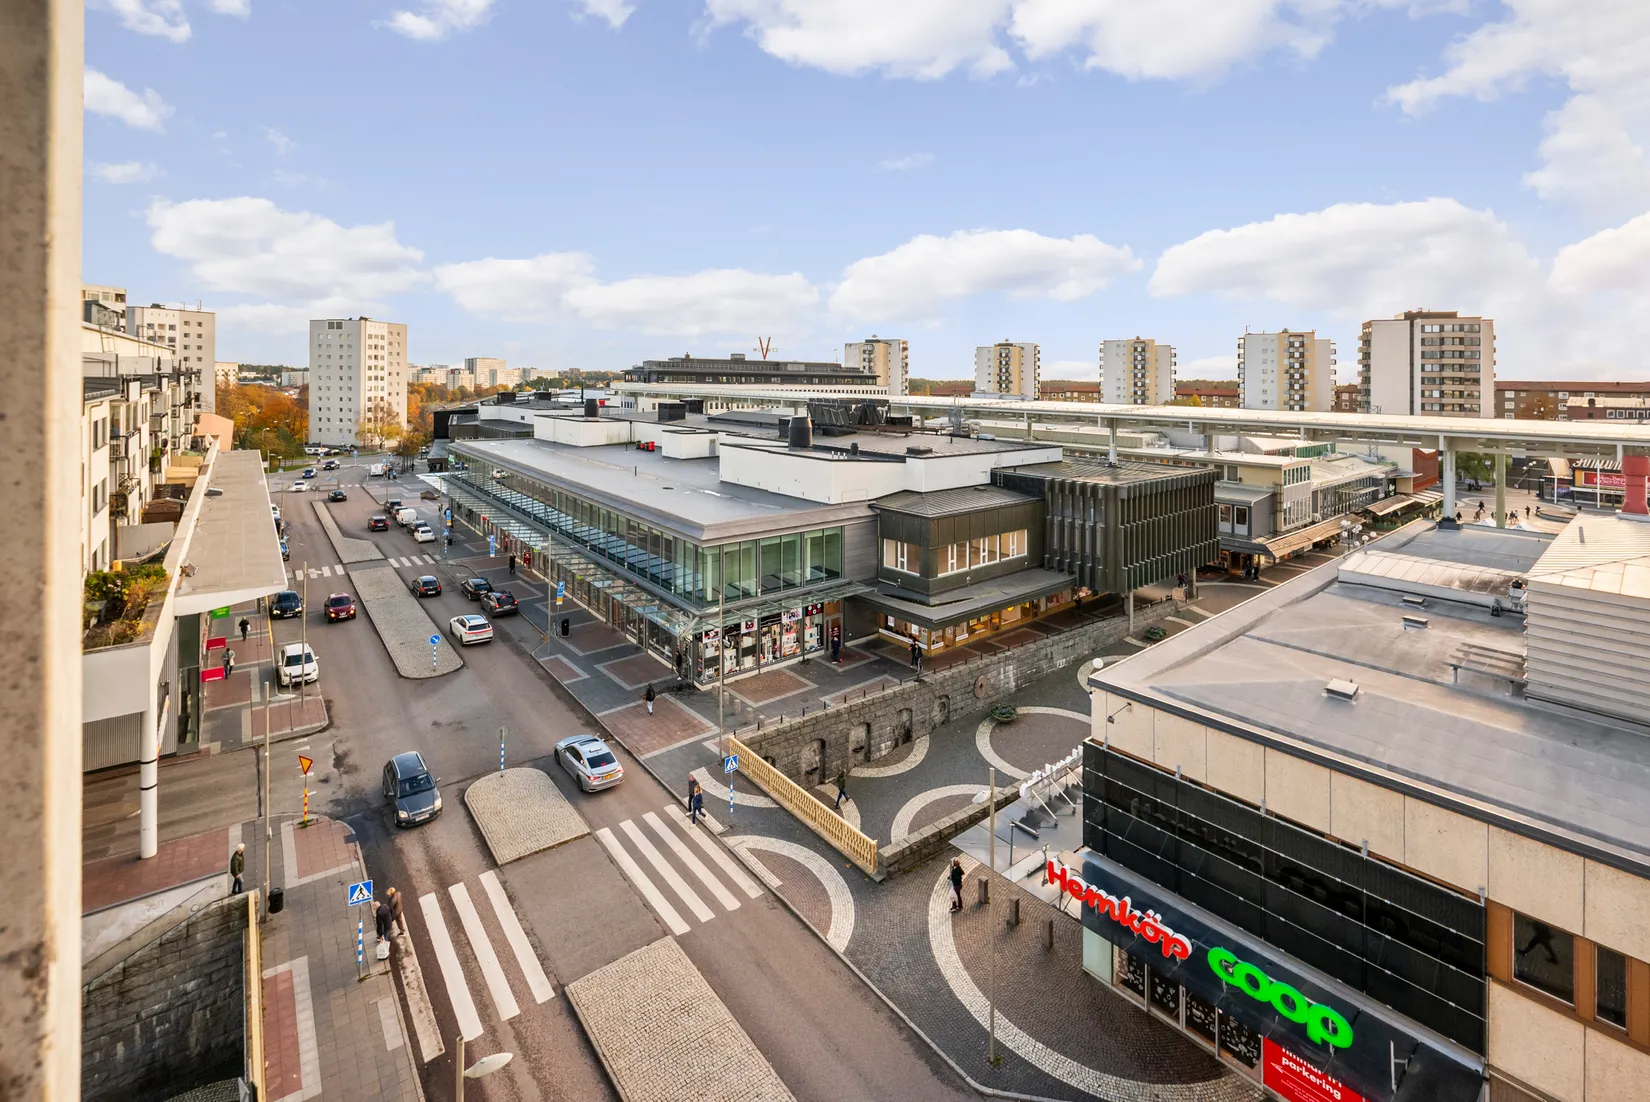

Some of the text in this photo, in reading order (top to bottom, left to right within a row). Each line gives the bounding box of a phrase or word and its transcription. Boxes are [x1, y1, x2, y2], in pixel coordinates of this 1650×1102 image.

[1047, 858, 1193, 961] Hemköp
[1207, 946, 1354, 1049] coop
[1282, 1056, 1342, 1100] parkering
